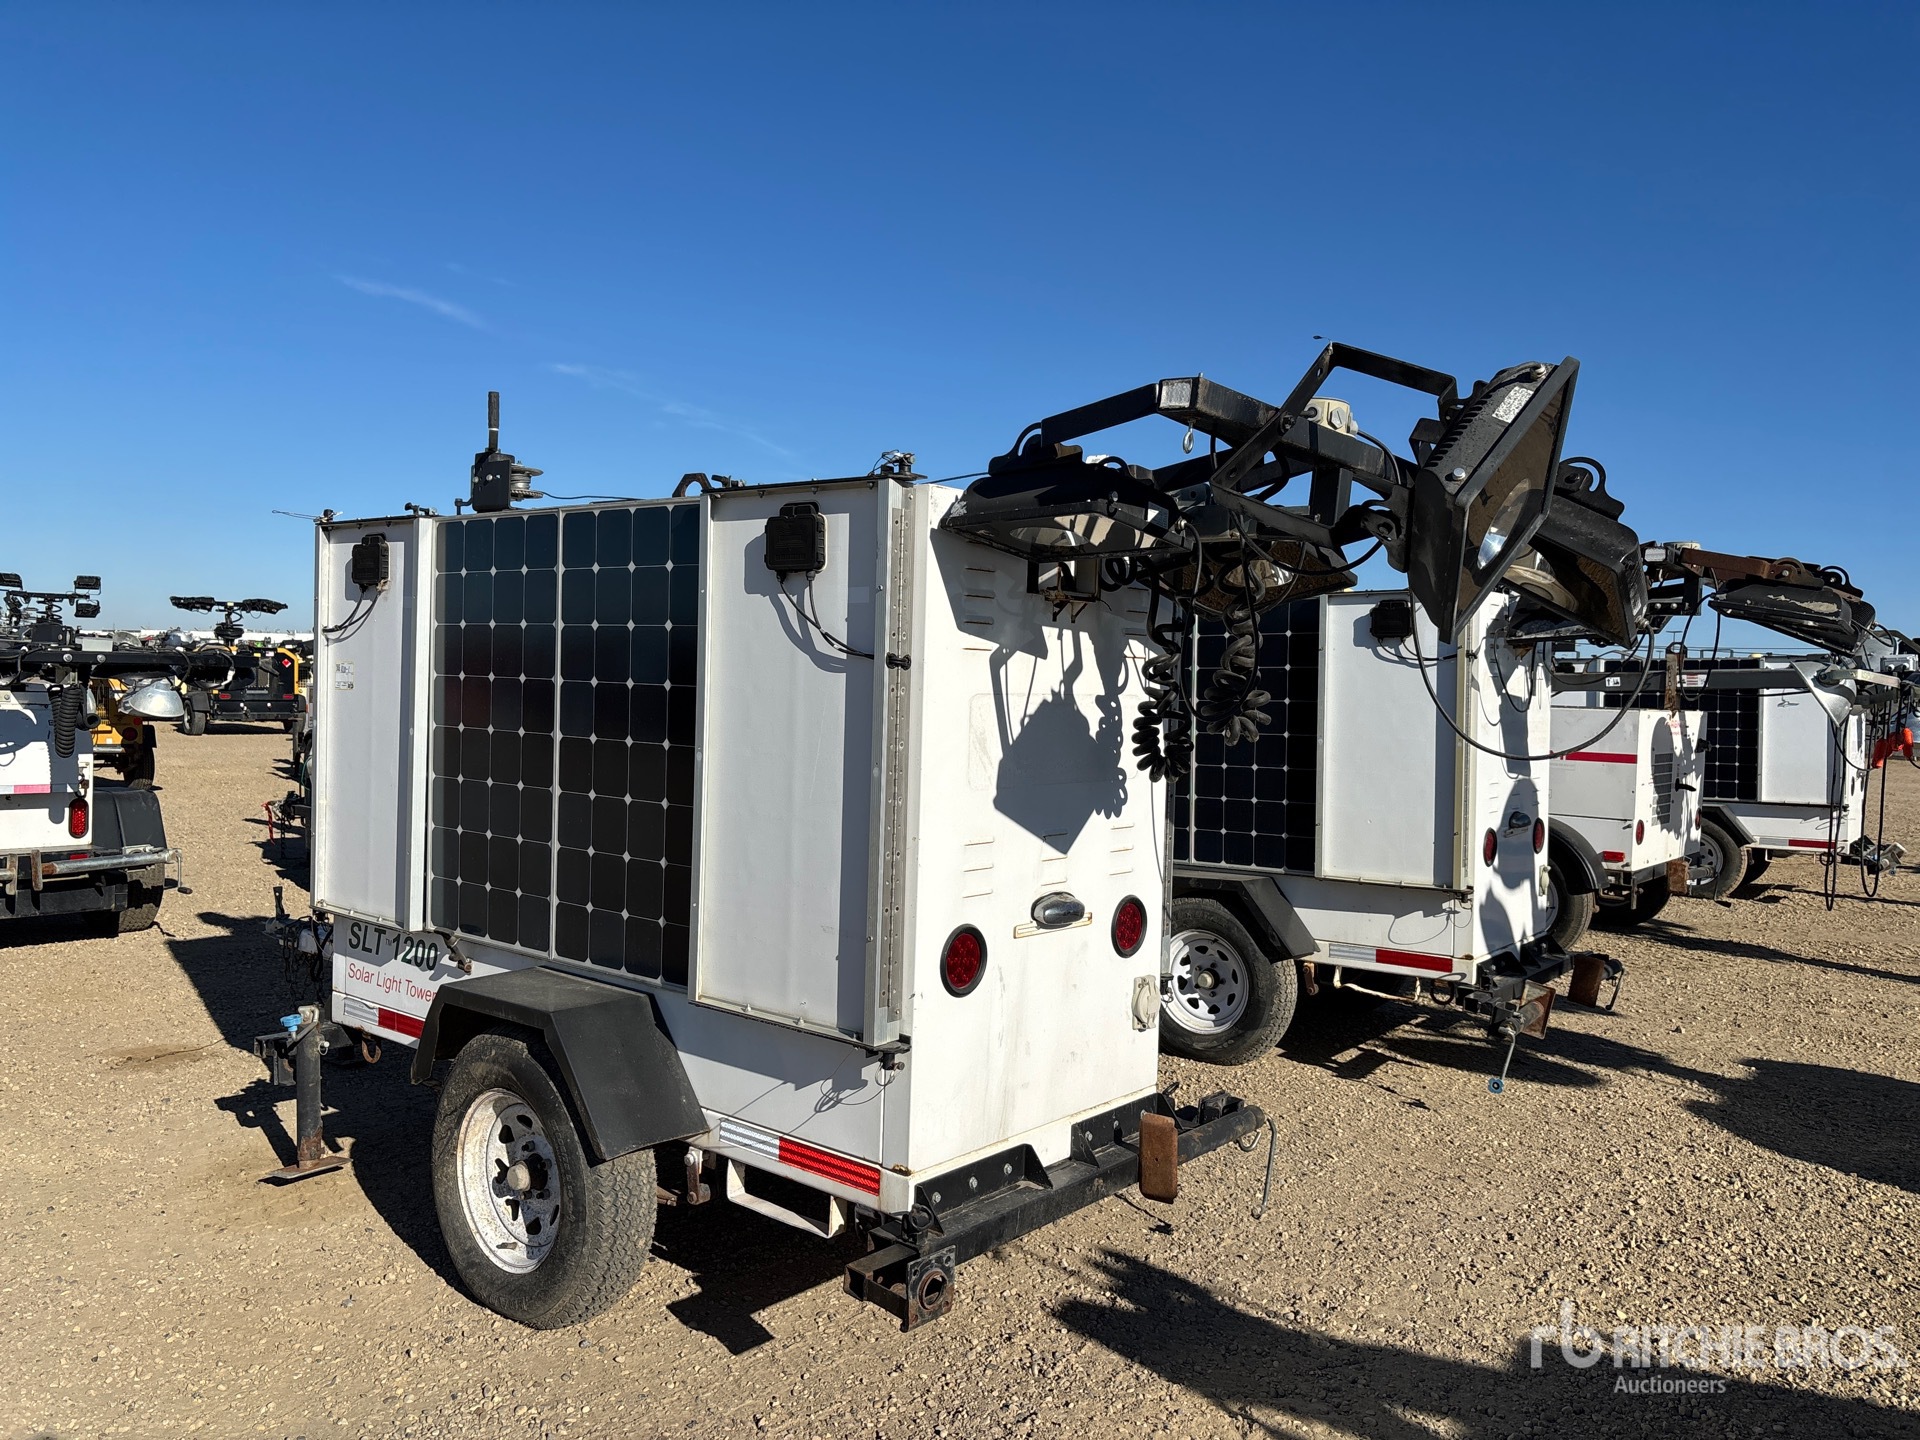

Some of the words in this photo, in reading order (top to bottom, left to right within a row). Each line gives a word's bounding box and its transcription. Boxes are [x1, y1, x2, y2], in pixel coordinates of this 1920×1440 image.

[349, 922, 386, 955] SLT
[393, 934, 438, 971] 1200
[348, 963, 374, 983] Solar
[376, 971, 402, 994] Light
[405, 979, 437, 1002] Tower
